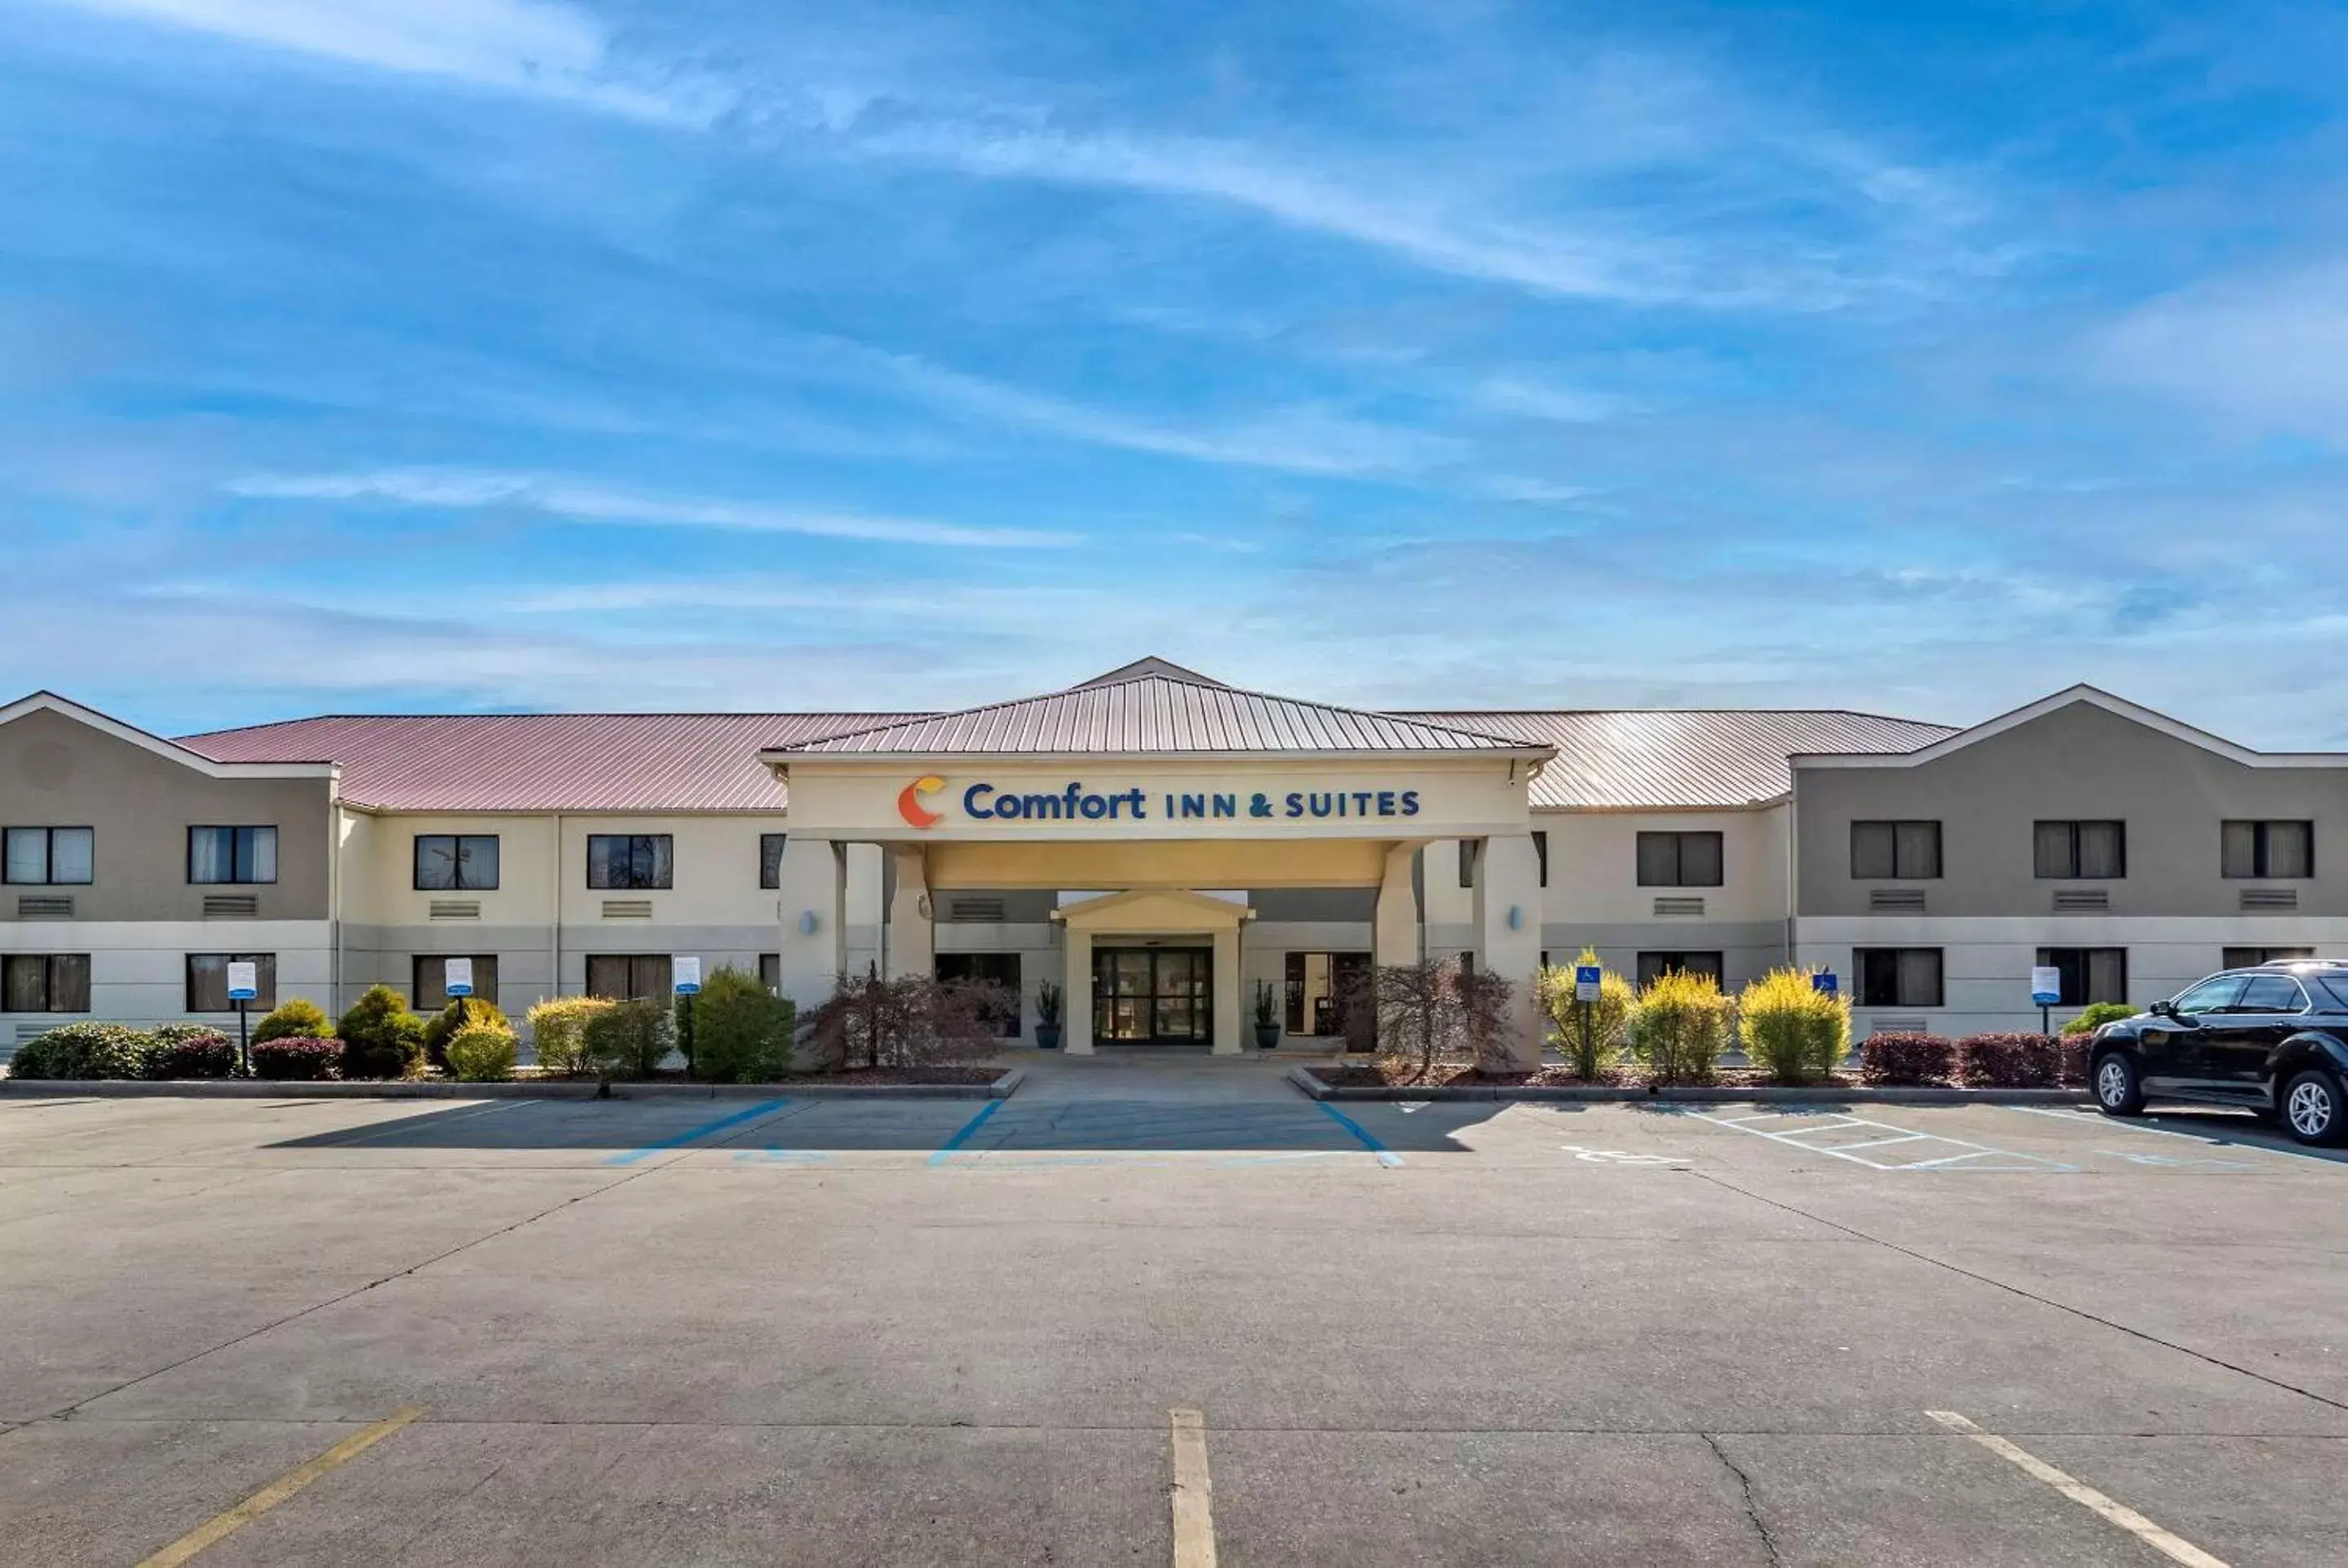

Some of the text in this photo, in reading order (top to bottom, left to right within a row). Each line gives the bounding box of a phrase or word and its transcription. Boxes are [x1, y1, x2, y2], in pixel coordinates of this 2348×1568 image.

[964, 782, 1421, 819] Comfort INN & SUITES
